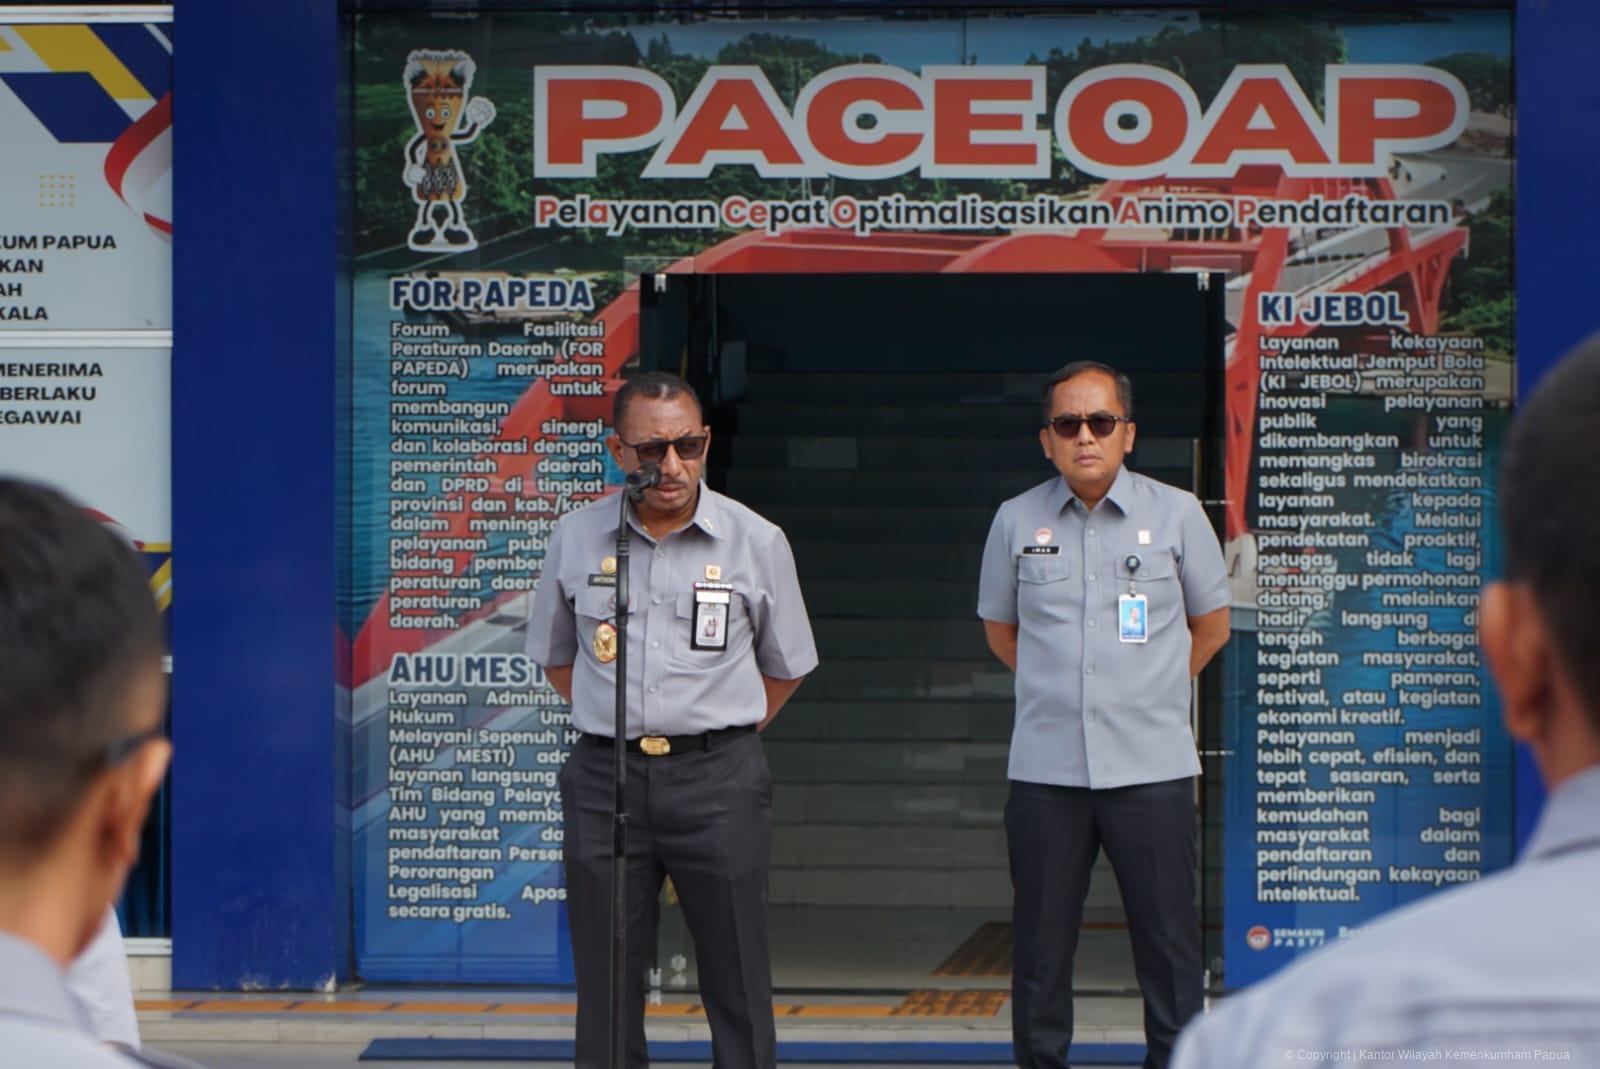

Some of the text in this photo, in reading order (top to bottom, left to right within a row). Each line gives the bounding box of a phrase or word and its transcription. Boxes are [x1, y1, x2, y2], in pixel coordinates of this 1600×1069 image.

[534, 64, 1470, 180] PACE OAP
[535, 194, 1453, 236] Pelayanan Cepat Optimalisasikan Animo Pendaftaran
[0, 236, 117, 249] UM PAPUA
[390, 277, 594, 311] FOR PAPEDA
[1258, 293, 1409, 327] KI JEBOL
[392, 322, 603, 336] Forum Fasilitasi
[392, 342, 603, 359] Peraturan Daerah (FOR
[1260, 336, 1483, 354] Layanan Kekayaan
[392, 361, 603, 379] PAPEDA) merupakan
[1260, 355, 1483, 373] Intelektual Jemput Bola
[391, 381, 603, 395] forum untuk
[1260, 371, 1483, 393] (KI JEBOL) merupakan
[0, 387, 96, 400] BERLAKU
[392, 400, 508, 417] membangun
[1260, 394, 1483, 412] inovasi pelayanan
[392, 420, 603, 437] komunikasi, sinergi
[1260, 414, 1482, 432] publik yang
[391, 439, 602, 457] dan kolaborasi dengan
[1260, 434, 1482, 453] dikembangkan untuk
[391, 459, 602, 476] pemerintah daerah
[1260, 453, 1481, 471] memangkas birokrasi
[391, 478, 602, 495] dan DPRD di tingkat
[1259, 473, 1481, 491] sekaligus mendekatkan
[391, 498, 462, 514] provinsi
[472, 498, 506, 512] dan
[1259, 493, 1481, 511] layanan kepada
[391, 517, 448, 531] dalam
[1258, 513, 1481, 530] masyarakat. Melalui
[391, 537, 487, 553] pelayanan
[1258, 533, 1481, 550] pendekatan proaktif,
[391, 557, 454, 573] bidang
[1366, 552, 1413, 567] tidak
[1447, 552, 1481, 570] lagi
[391, 578, 481, 592] peraturan
[1258, 572, 1480, 589] menunggu permohonan
[391, 597, 480, 611] peraturan
[1383, 592, 1479, 606] melainkan
[390, 615, 459, 628] daerah.
[1258, 611, 1305, 626] hadir
[1342, 611, 1427, 629] langsung
[1257, 631, 1479, 649] tengah berbagai
[1257, 651, 1480, 669] kegiatan masyarakat,
[388, 653, 456, 686] AHU
[1257, 670, 1480, 689] seperti pameran,
[389, 690, 567, 708] Layanan Adminis
[1257, 690, 1480, 708] festival, atau kegiatan
[389, 711, 454, 723] Hukum
[1257, 709, 1405, 724] ekonomi kreatif.
[389, 729, 472, 746] Melayani
[479, 728, 556, 746] Sepenuh
[1257, 729, 1480, 748] Pelayanan menjadi
[390, 749, 434, 765] (AHU
[457, 749, 515, 766] MESTI)
[1257, 749, 1480, 767] lebih cepat, efisien, dan
[389, 768, 556, 786] layanan langsung
[1257, 770, 1480, 788] tepat sasaran, serta
[389, 787, 422, 801] Tim
[432, 787, 495, 805] Bidang
[1257, 788, 1375, 803] memberikan
[389, 807, 426, 821] AHU
[440, 809, 485, 825] yang
[1257, 807, 1480, 827] kemudahan bagi
[389, 827, 499, 843] masyarakat
[1257, 828, 1480, 845] masyarakat dalam
[389, 846, 501, 864] pendaftaran
[1257, 847, 1480, 865] pendaftaran dan
[389, 865, 493, 883] Perorangan
[1257, 866, 1480, 885] perlindungan kekayaan
[389, 884, 477, 901] Legalisasi
[1257, 887, 1359, 901] intelektual.
[389, 903, 511, 922] secara gratis.
